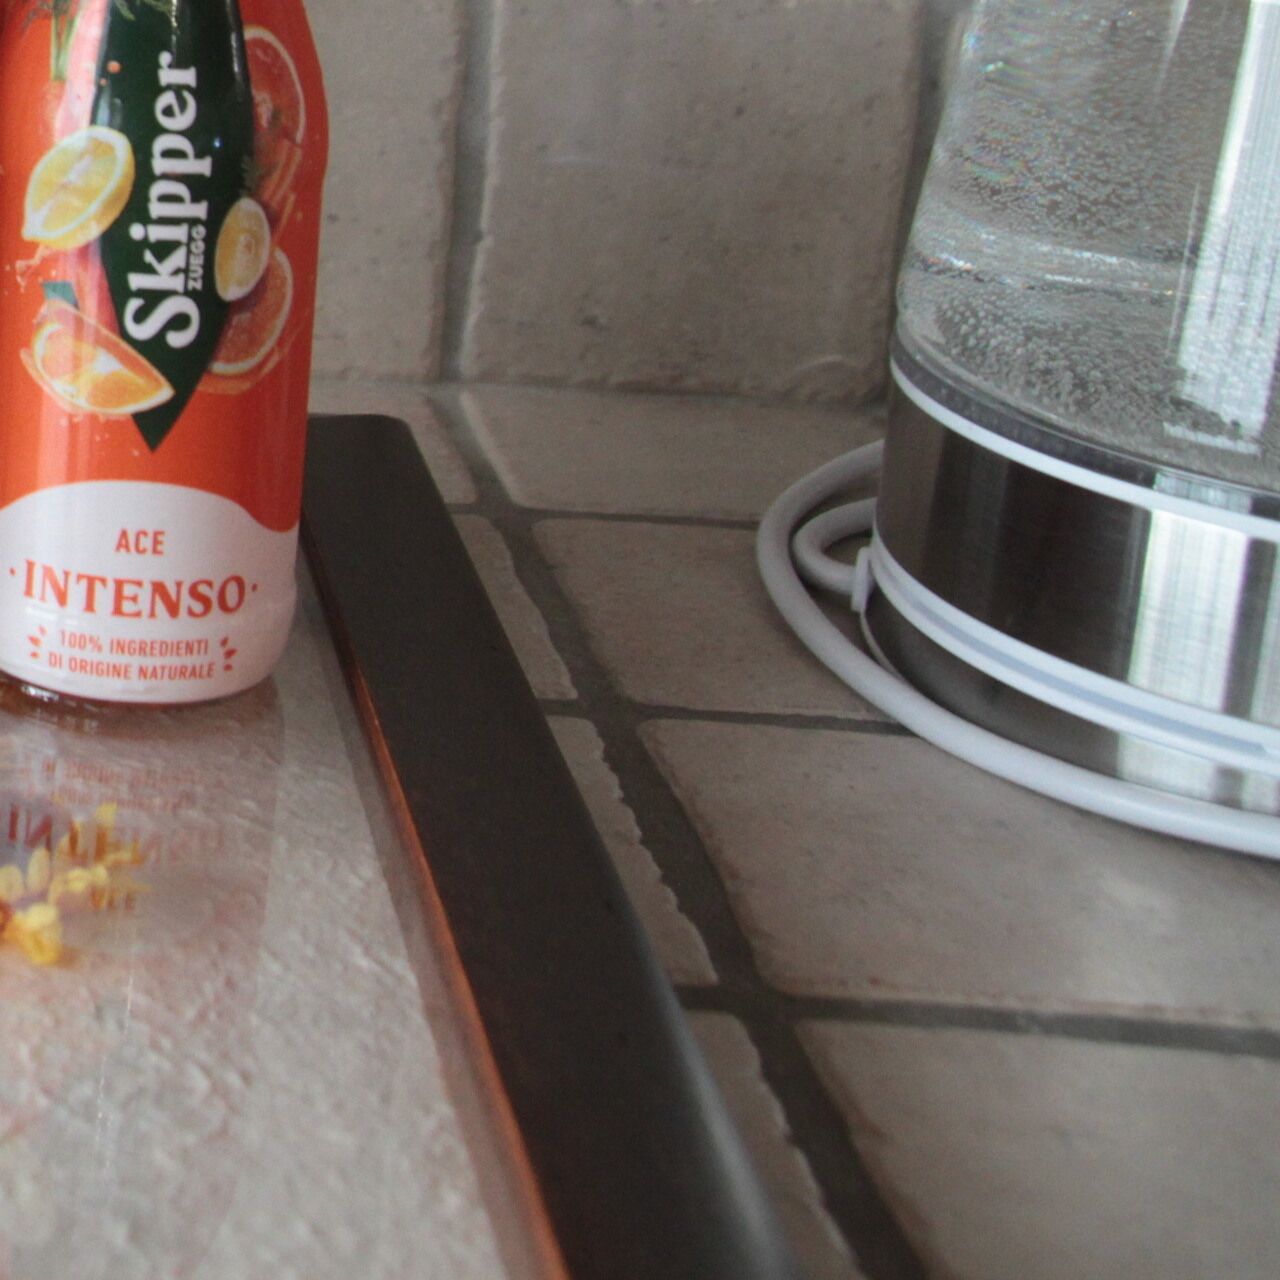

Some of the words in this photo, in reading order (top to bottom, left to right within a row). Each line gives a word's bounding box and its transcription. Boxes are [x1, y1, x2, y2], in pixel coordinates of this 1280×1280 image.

[124, 51, 213, 349] Skipper
[187, 224, 207, 291] ZUEGG
[114, 528, 166, 556] ACE
[22, 558, 247, 620] INTENSO
[59, 629, 103, 652] 100%
[109, 636, 209, 657] INGREDIENTI
[48, 653, 63, 670] DI
[69, 657, 132, 681] ORIGINE
[137, 661, 217, 681] NATURALE
